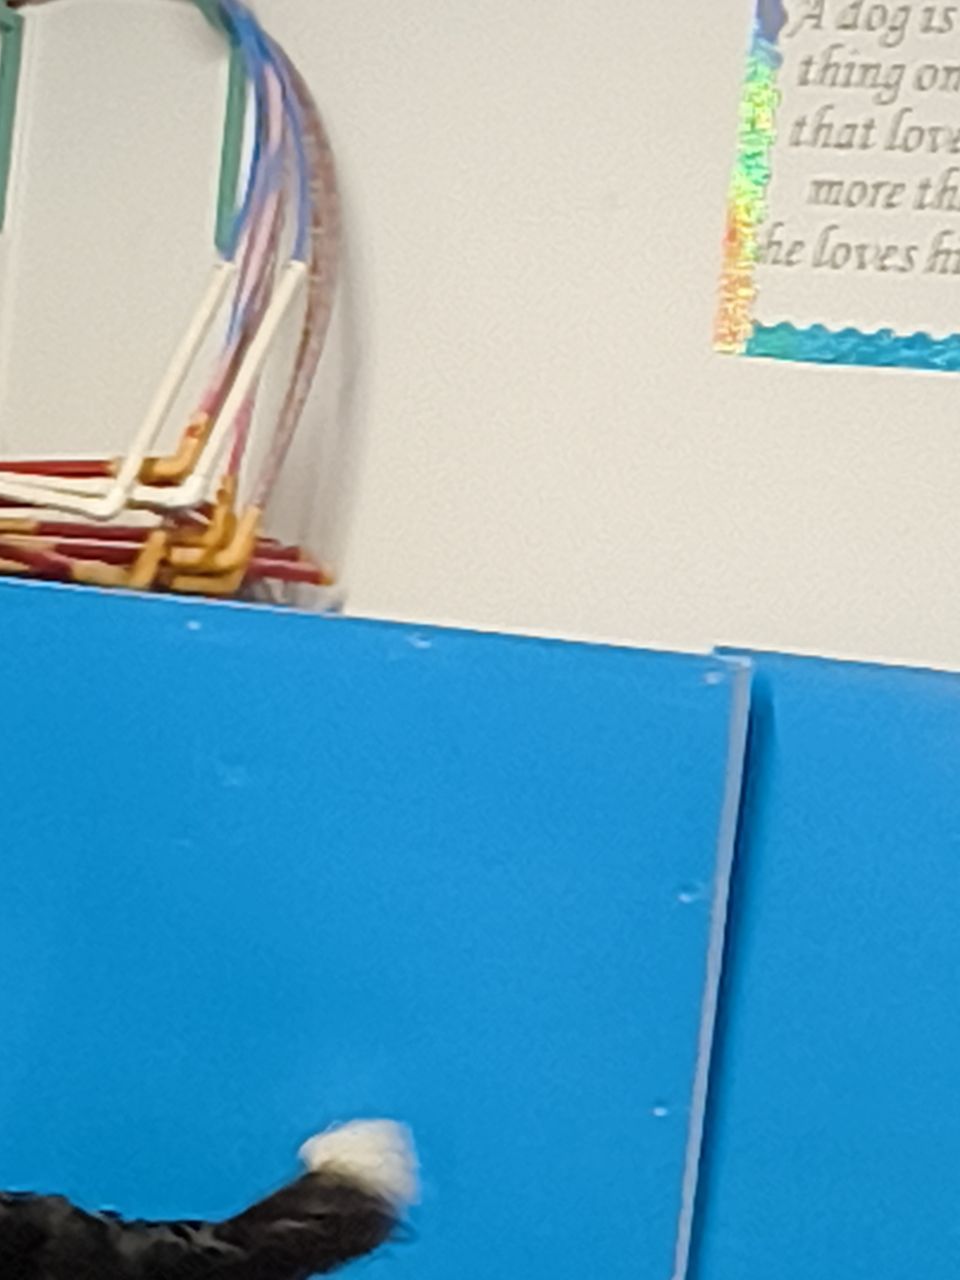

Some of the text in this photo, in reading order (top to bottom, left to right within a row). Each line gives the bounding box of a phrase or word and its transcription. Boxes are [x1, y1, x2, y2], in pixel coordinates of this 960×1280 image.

[836, 0, 911, 47] dog
[921, 6, 958, 34] is
[798, 43, 906, 105] thing
[790, 104, 876, 149] that
[808, 180, 906, 209] more
[760, 222, 805, 265] he
[813, 225, 918, 272] loves
